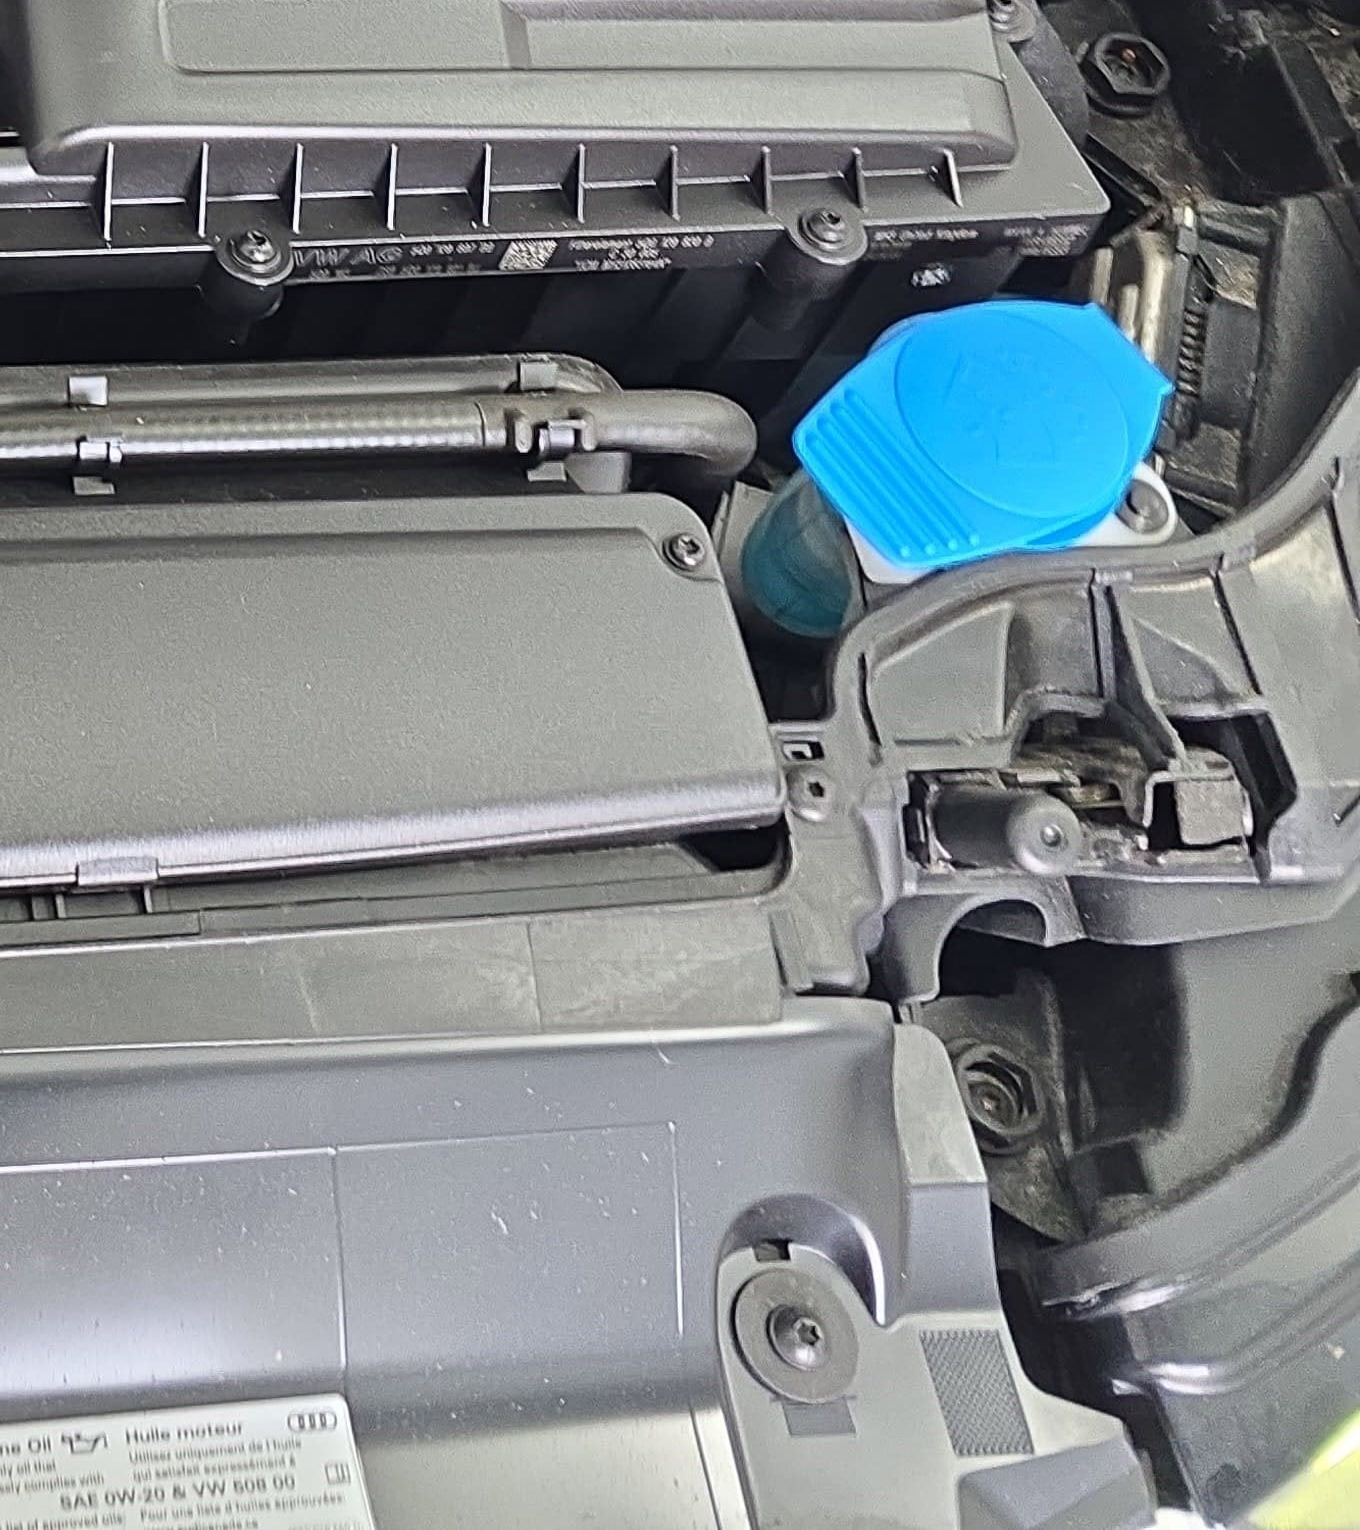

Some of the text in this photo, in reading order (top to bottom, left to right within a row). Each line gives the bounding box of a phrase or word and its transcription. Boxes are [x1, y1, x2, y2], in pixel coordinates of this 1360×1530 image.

[28, 1434, 52, 1454] Oil
[126, 1422, 243, 1445] Huile moteur
[16, 1461, 31, 1476] oil
[34, 1458, 57, 1473] that
[24, 1476, 77, 1494] complies
[80, 1471, 105, 1487] with
[60, 1492, 98, 1511] SAE
[173, 1485, 186, 1500] &
[192, 1479, 227, 1498] VW
[272, 1473, 296, 1490] 00
